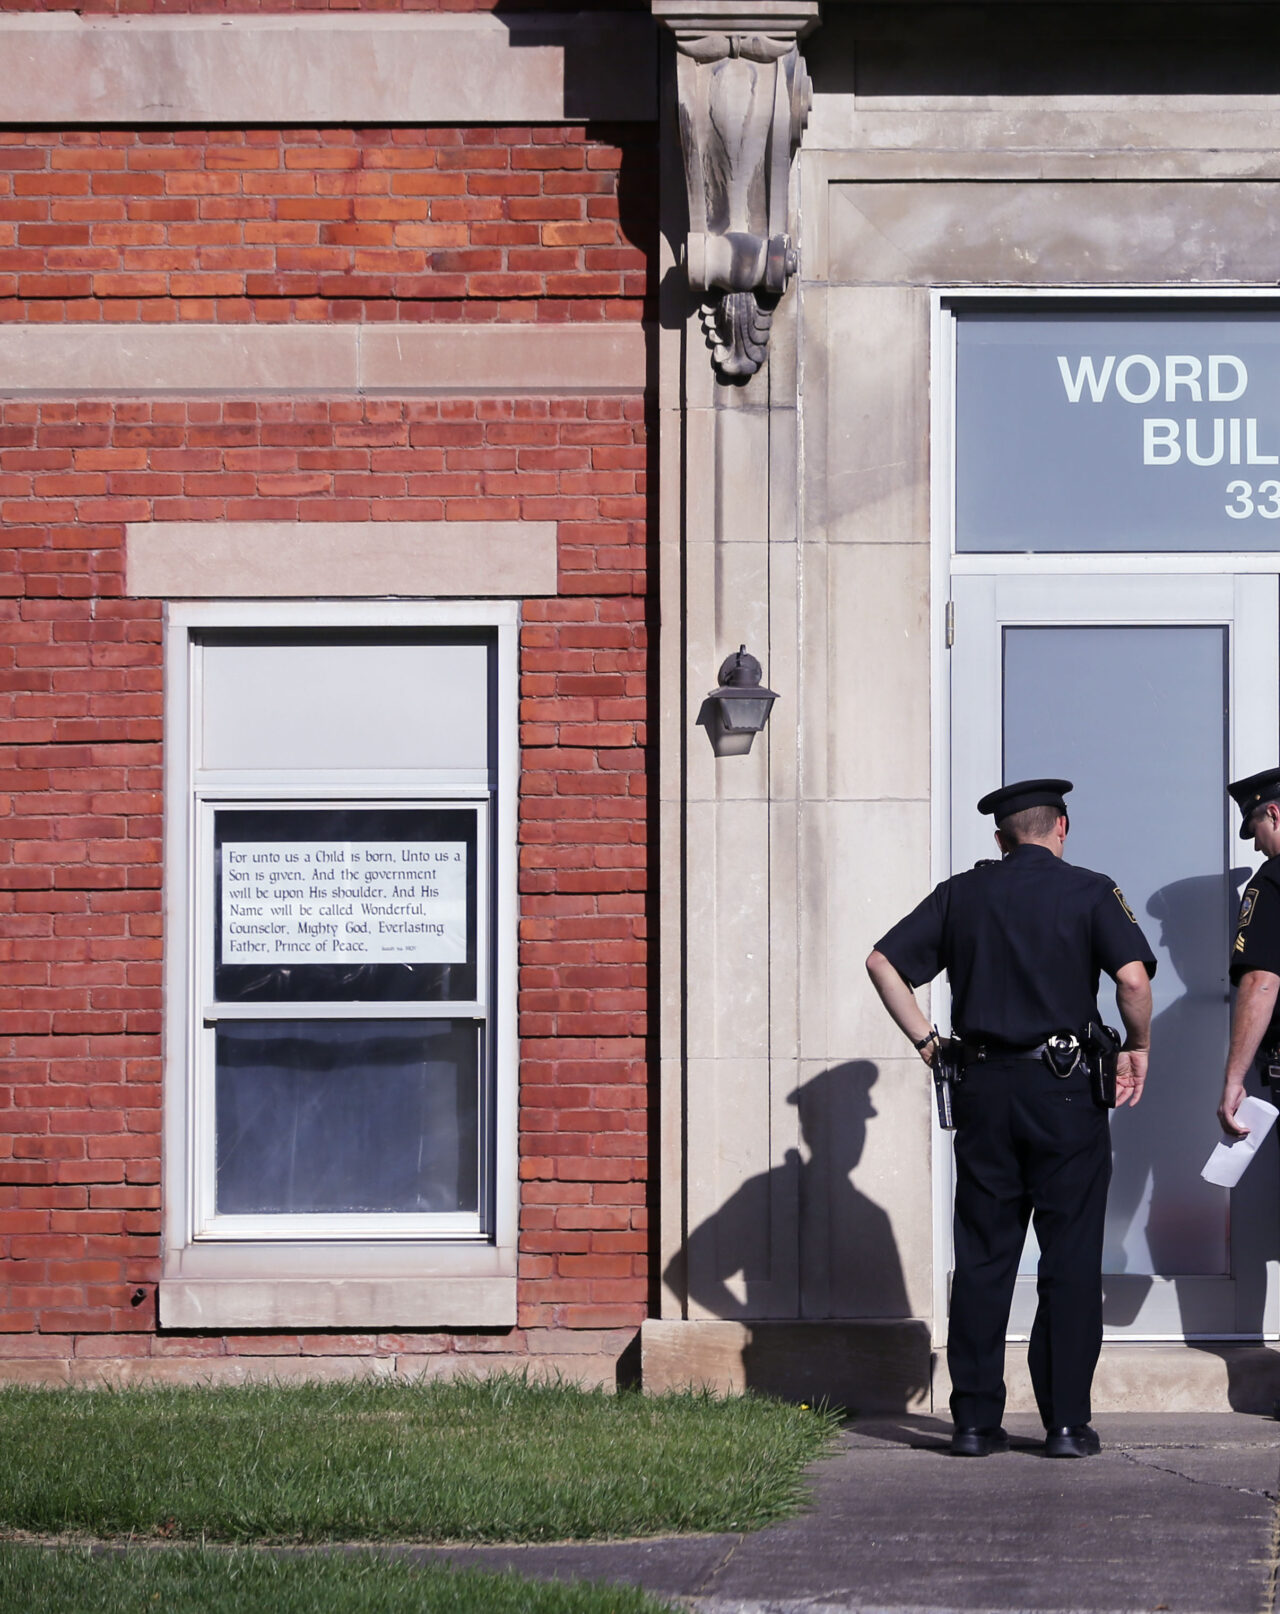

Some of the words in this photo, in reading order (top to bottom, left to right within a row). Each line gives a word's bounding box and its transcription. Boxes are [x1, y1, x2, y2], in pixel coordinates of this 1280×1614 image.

[1057, 355, 1248, 403] WORD
[228, 851, 248, 863] For
[251, 853, 281, 863] unto
[284, 854, 300, 863] us
[304, 854, 311, 862] a
[315, 850, 345, 863] Child
[350, 853, 361, 862] is
[401, 850, 431, 862] Unto
[434, 853, 450, 861] us
[454, 853, 460, 861] a
[228, 869, 251, 881] Son
[255, 872, 265, 881] is
[311, 867, 336, 880] And
[340, 868, 360, 880] the
[364, 869, 437, 884] government
[228, 887, 252, 899] will
[255, 887, 270, 899] be
[273, 890, 305, 901] upon
[308, 885, 328, 898] His
[391, 885, 416, 898] And
[420, 885, 440, 897] His
[229, 904, 264, 916] Name
[269, 904, 293, 916] will
[298, 904, 313, 916] be
[318, 904, 354, 916] called
[297, 921, 339, 937] Mighty
[378, 921, 445, 936] Everlasting
[274, 940, 312, 952] Prince
[314, 939, 329, 951] of
